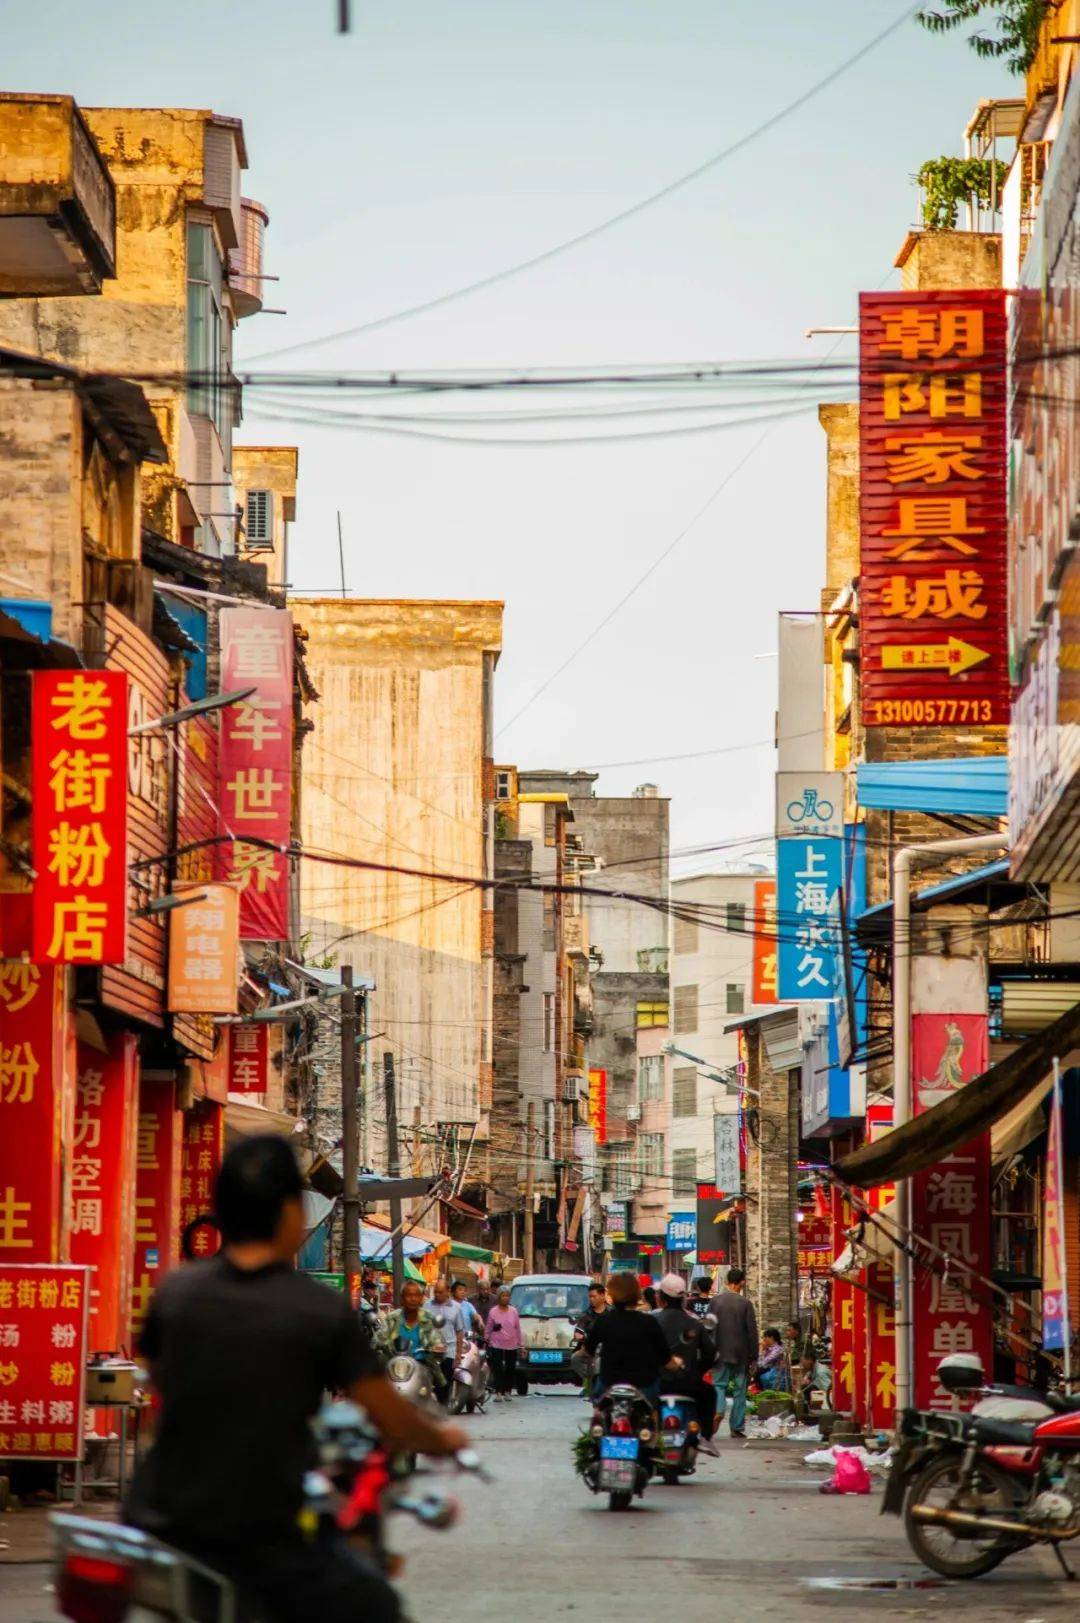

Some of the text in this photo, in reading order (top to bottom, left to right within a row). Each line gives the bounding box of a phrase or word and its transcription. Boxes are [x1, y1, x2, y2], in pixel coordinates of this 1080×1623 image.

[878, 308, 988, 620] 朝阳家具城
[227, 625, 284, 893] 童车世界
[874, 700, 991, 722] 13100577713
[49, 675, 112, 961] 老街粉店
[795, 845, 834, 988] 上海永久
[233, 1024, 260, 1089] 童车
